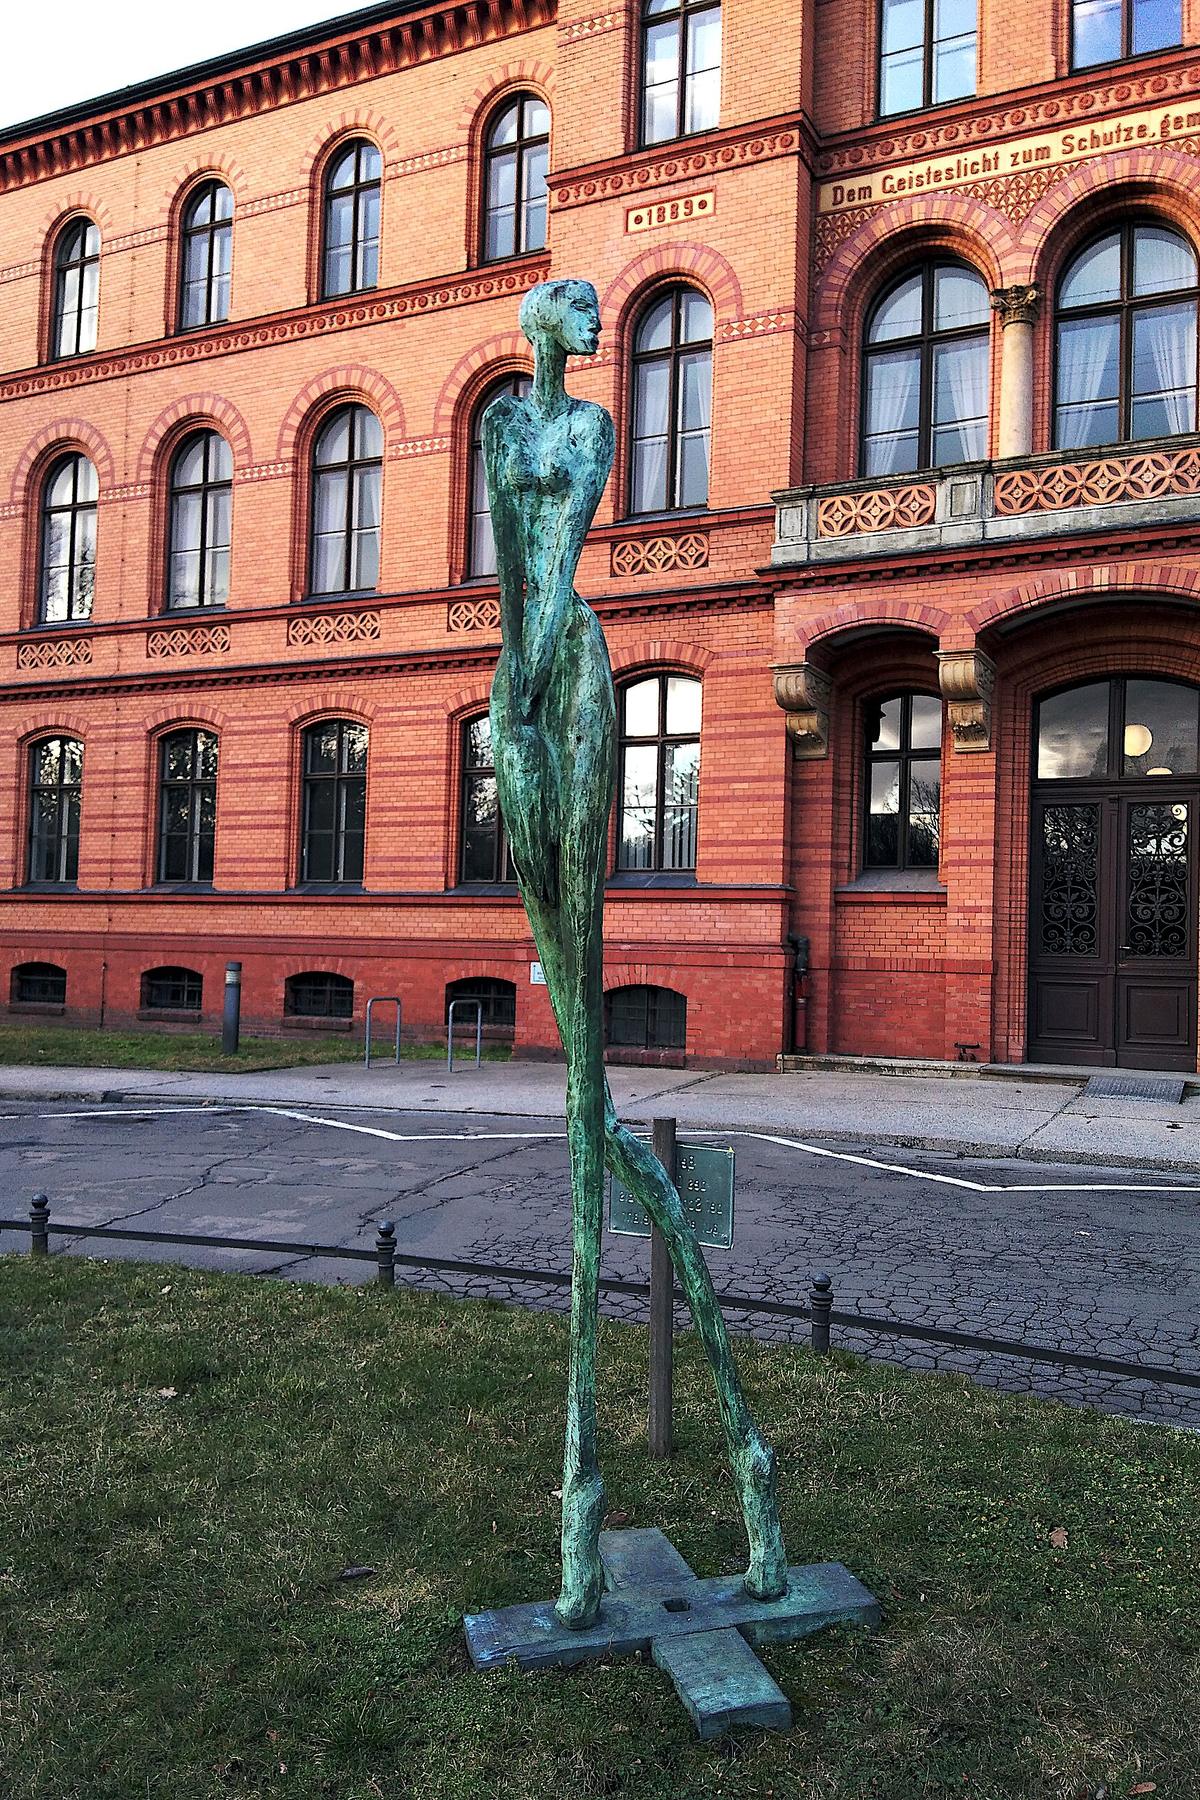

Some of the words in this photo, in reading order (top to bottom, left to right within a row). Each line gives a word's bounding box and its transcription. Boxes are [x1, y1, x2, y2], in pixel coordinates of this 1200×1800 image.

[831, 184, 872, 206] Dem
[881, 152, 1000, 194] Geisteslicht
[1010, 145, 1051, 167] zum
[1061, 122, 1156, 155] Schutze,
[647, 199, 694, 226] 1889
